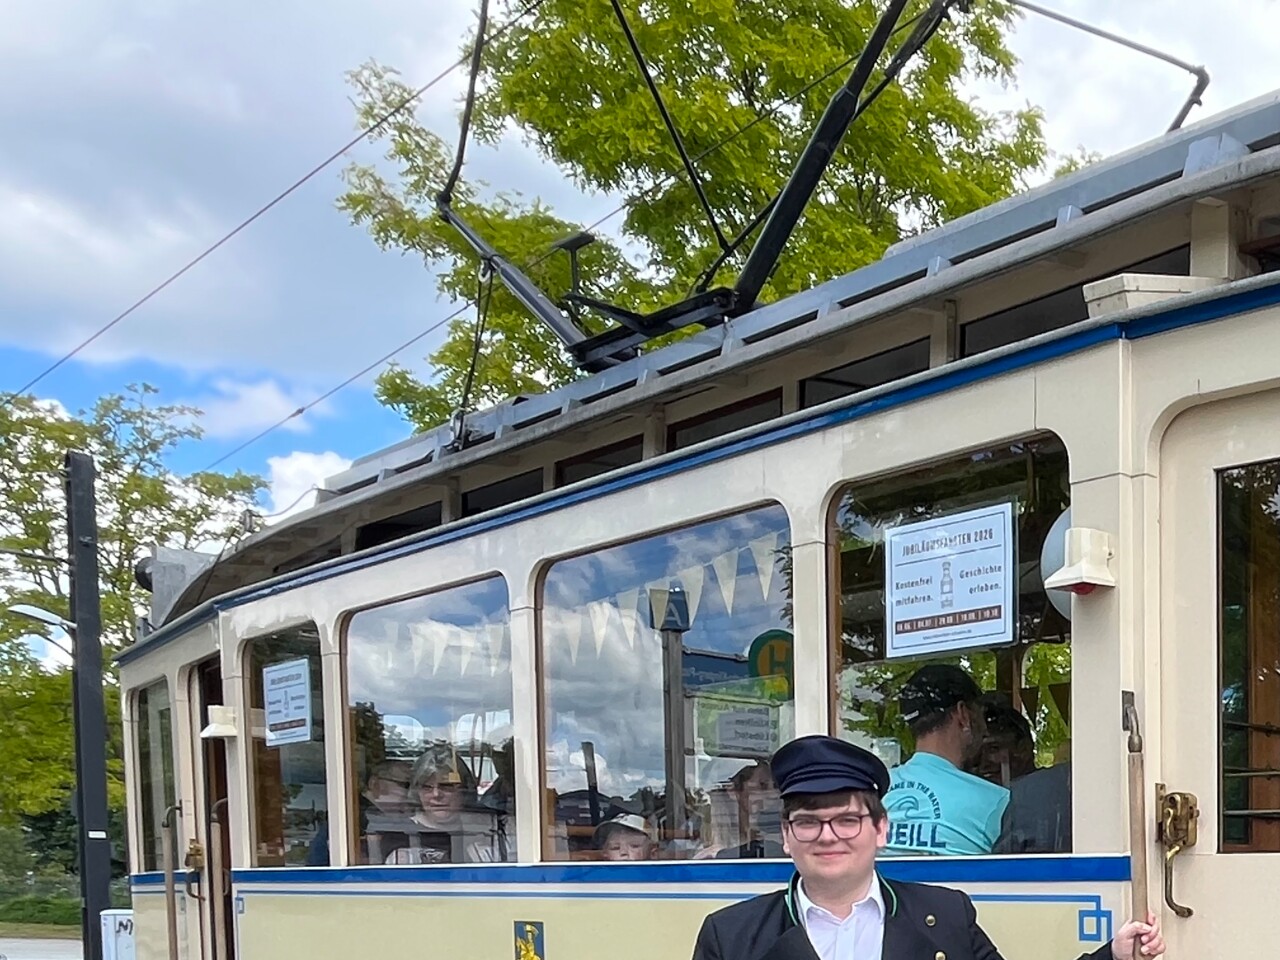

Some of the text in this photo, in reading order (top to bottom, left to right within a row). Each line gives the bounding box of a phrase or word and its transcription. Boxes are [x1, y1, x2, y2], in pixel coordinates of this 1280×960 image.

[974, 528, 993, 542] 2026
[959, 565, 1002, 579] Geschichte
[895, 576, 933, 590] Kostenfrei
[969, 583, 1002, 594] erleben.
[895, 594, 934, 607] mitfahren.
[906, 781, 915, 789] IN
[916, 782, 930, 795] THE
[928, 792, 941, 819] WATER
